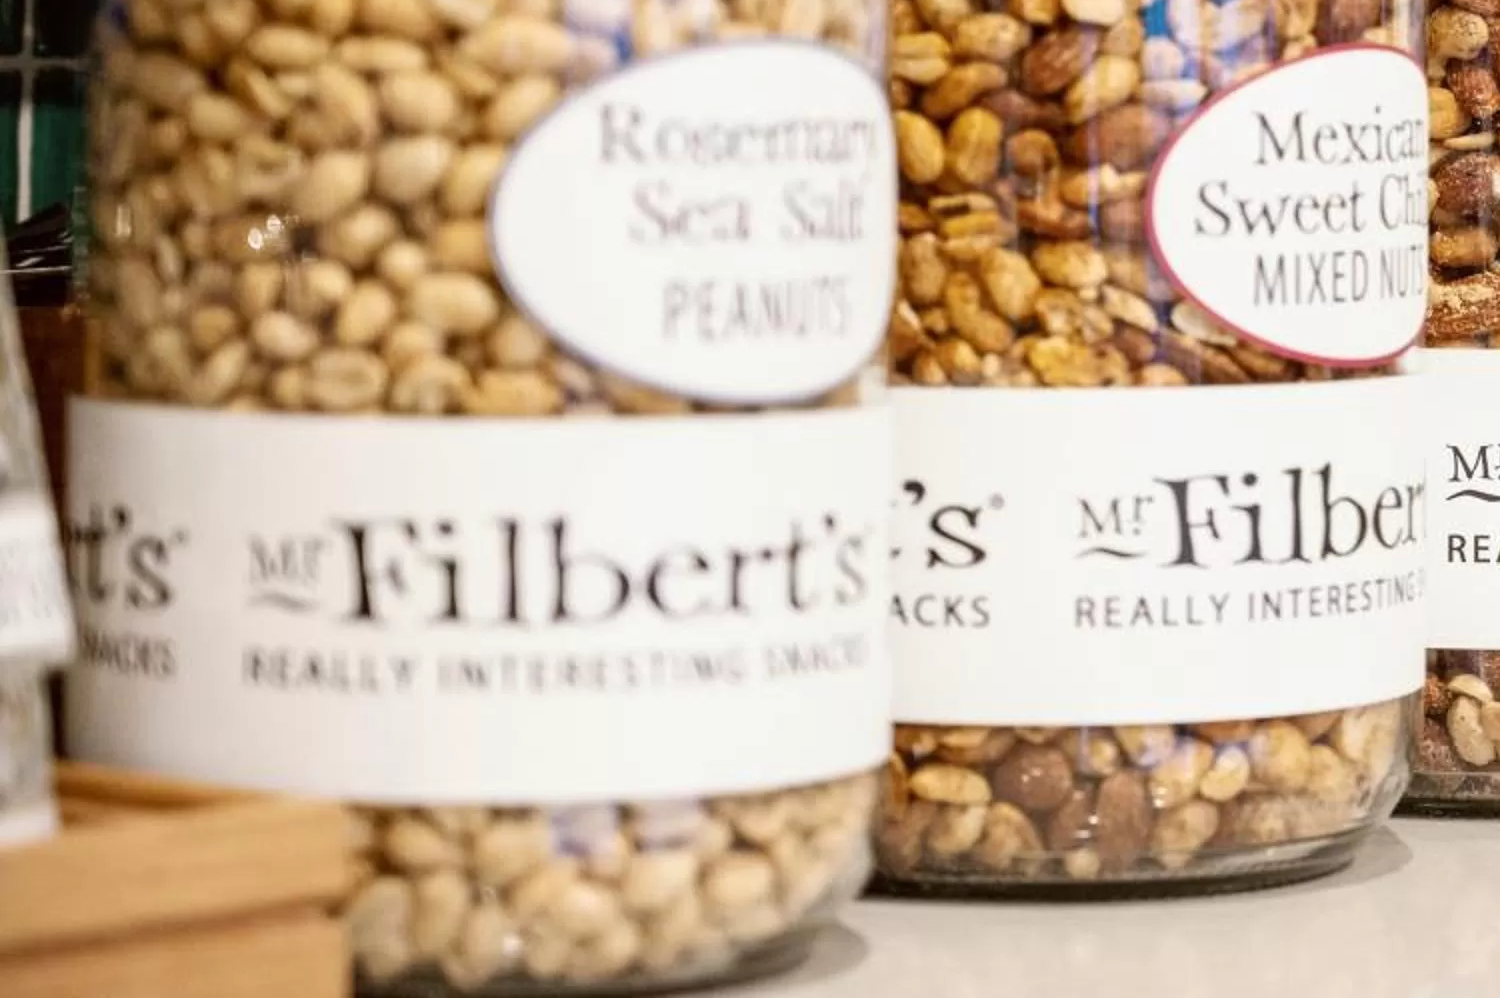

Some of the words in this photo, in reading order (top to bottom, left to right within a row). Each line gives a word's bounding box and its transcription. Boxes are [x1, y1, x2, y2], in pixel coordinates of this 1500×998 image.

[627, 176, 753, 245] Sea
[1194, 180, 1366, 237] Sweet
[1254, 249, 1369, 306] MIXED
[1077, 494, 1154, 540] Mr
[1153, 462, 1425, 569] Filber
[333, 513, 873, 630] Filbert's
[1075, 592, 1230, 628] REALLY
[1248, 571, 1416, 622] INTERESTING
[240, 643, 414, 695] REALLY
[436, 644, 746, 697] INTERESTING
